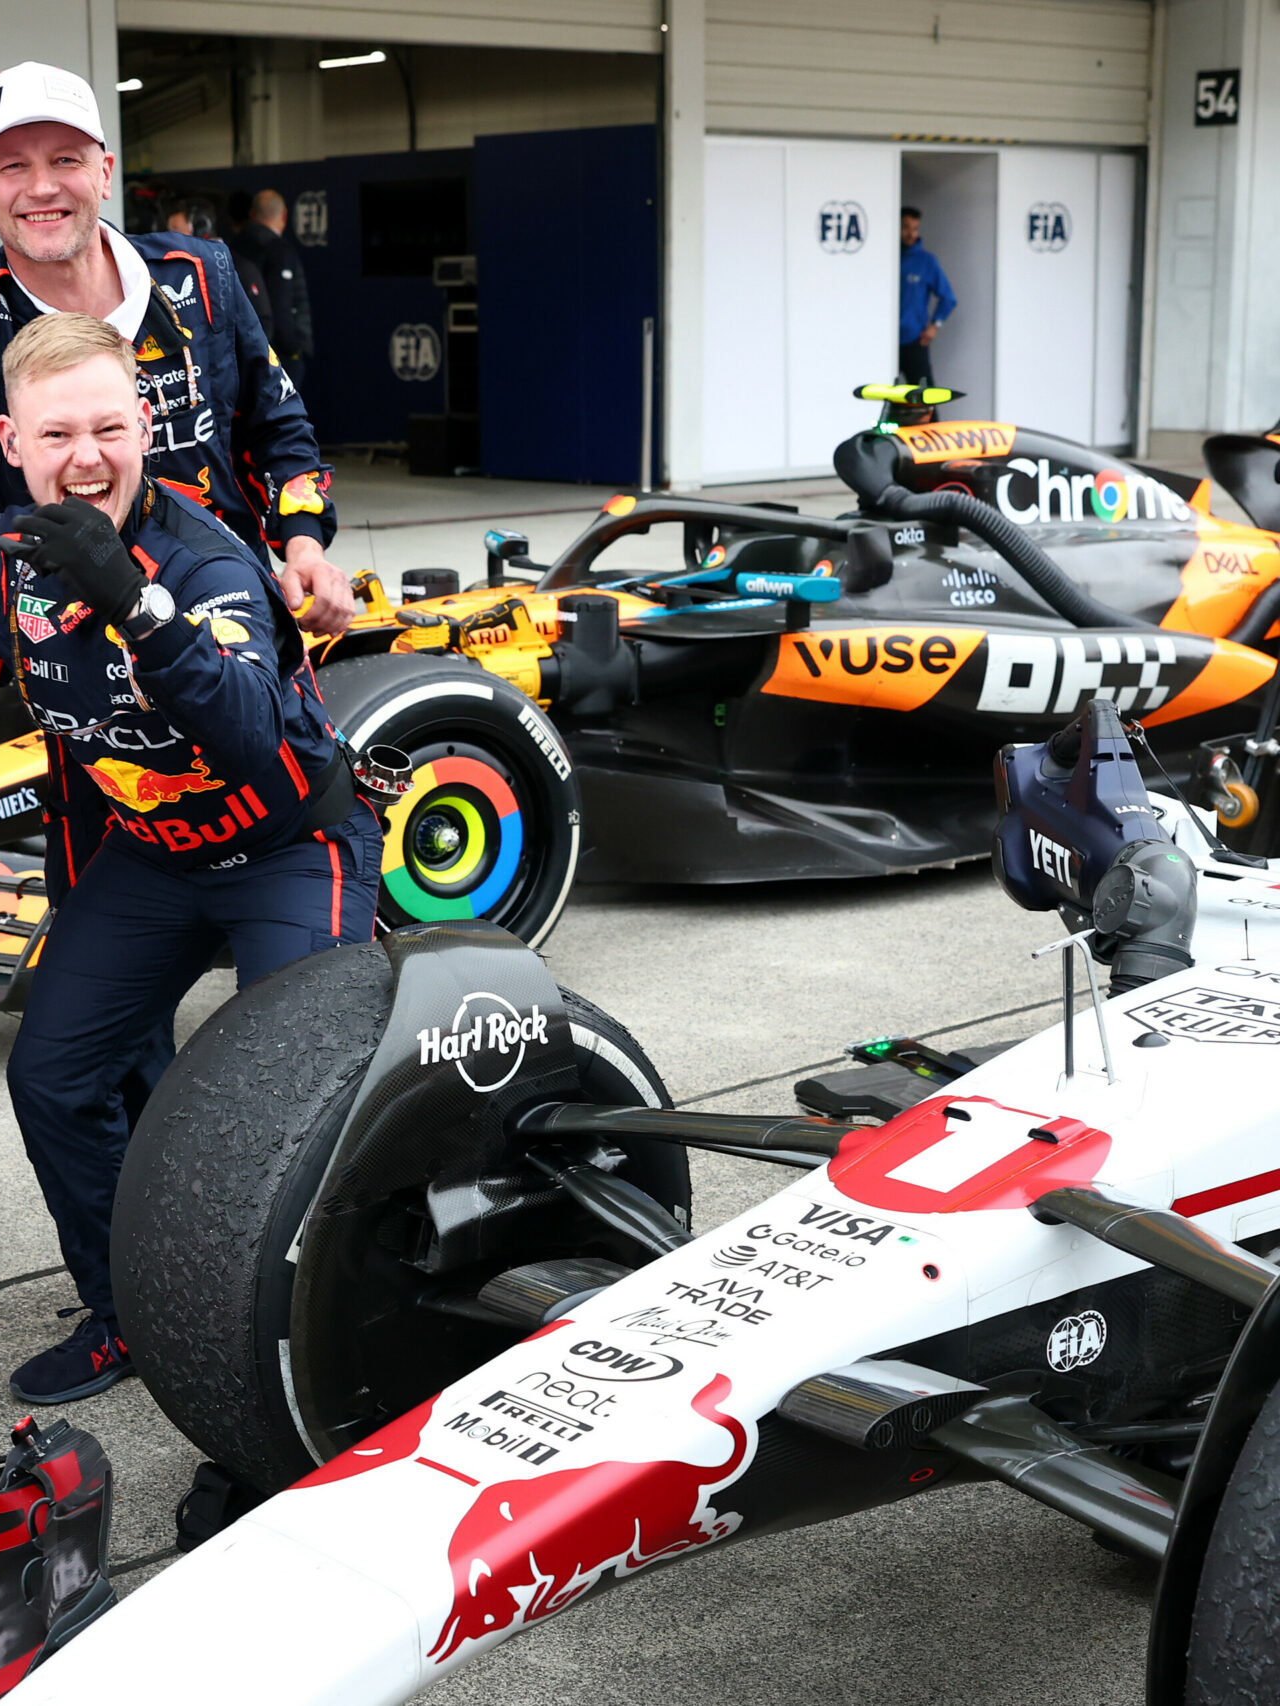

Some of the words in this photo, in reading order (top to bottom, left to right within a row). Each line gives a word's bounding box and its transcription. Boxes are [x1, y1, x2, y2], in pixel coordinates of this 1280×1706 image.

[1197, 78, 1237, 119] 54
[910, 428, 1009, 455] allwyn
[895, 527, 926, 545] okta
[1203, 552, 1260, 576] DELL
[22, 656, 49, 680] obil
[976, 633, 1177, 715] OKX
[517, 704, 572, 782] PIRELLI
[152, 783, 270, 852] Bull
[1029, 828, 1073, 889] YETI
[416, 1020, 483, 1065] Hard
[485, 1004, 549, 1055] Rock
[884, 1101, 1061, 1195] 1
[798, 1202, 896, 1246] VISA
[772, 1232, 867, 1268] Gate.io
[749, 1260, 835, 1291] AT&T
[665, 1282, 773, 1326] TRADE
[569, 1340, 656, 1375] CDW
[443, 1411, 532, 1454] Mobil
[478, 1390, 595, 1442] PIRELLI
